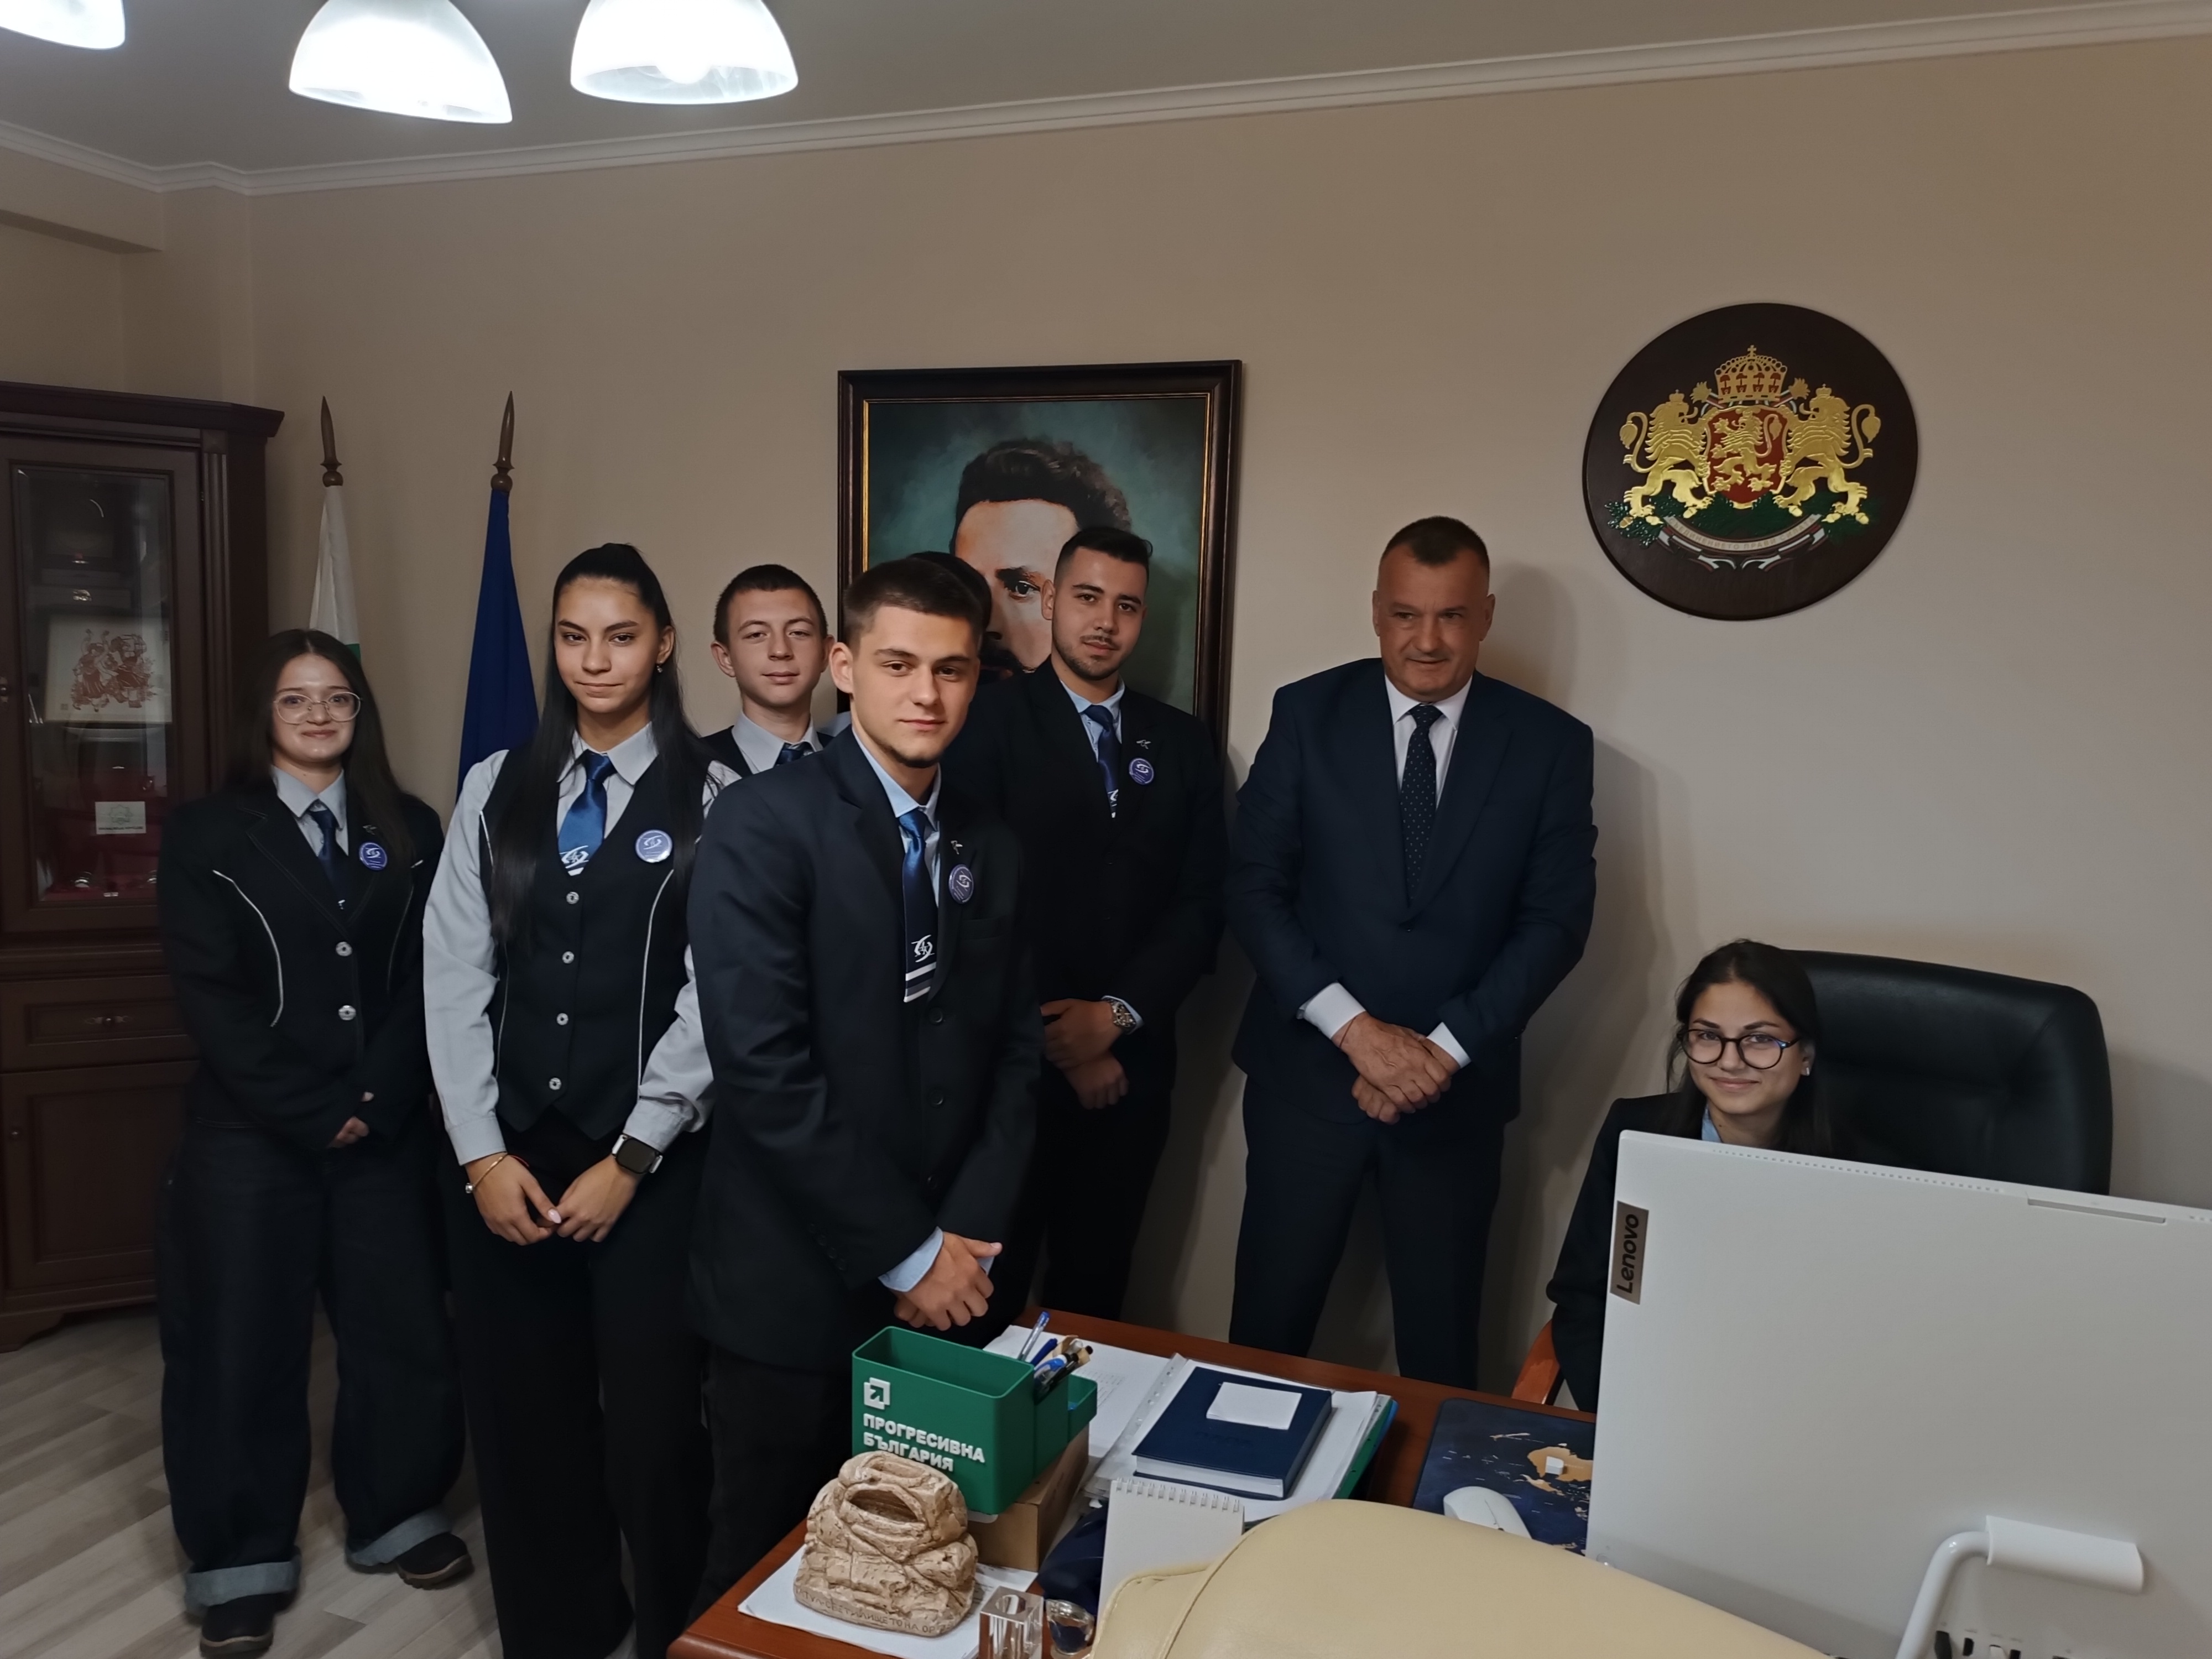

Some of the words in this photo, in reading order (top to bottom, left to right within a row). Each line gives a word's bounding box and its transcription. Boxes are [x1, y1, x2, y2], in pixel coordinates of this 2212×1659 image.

[1744, 539, 1776, 549] ПРАВИ
[1778, 518, 1814, 541] СИЛАТА
[1616, 1214, 1639, 1294] Lenovo
[863, 1413, 985, 1463] ПРОГРЕСИВНА
[863, 1432, 954, 1472] БЪЛГАРИЯ
